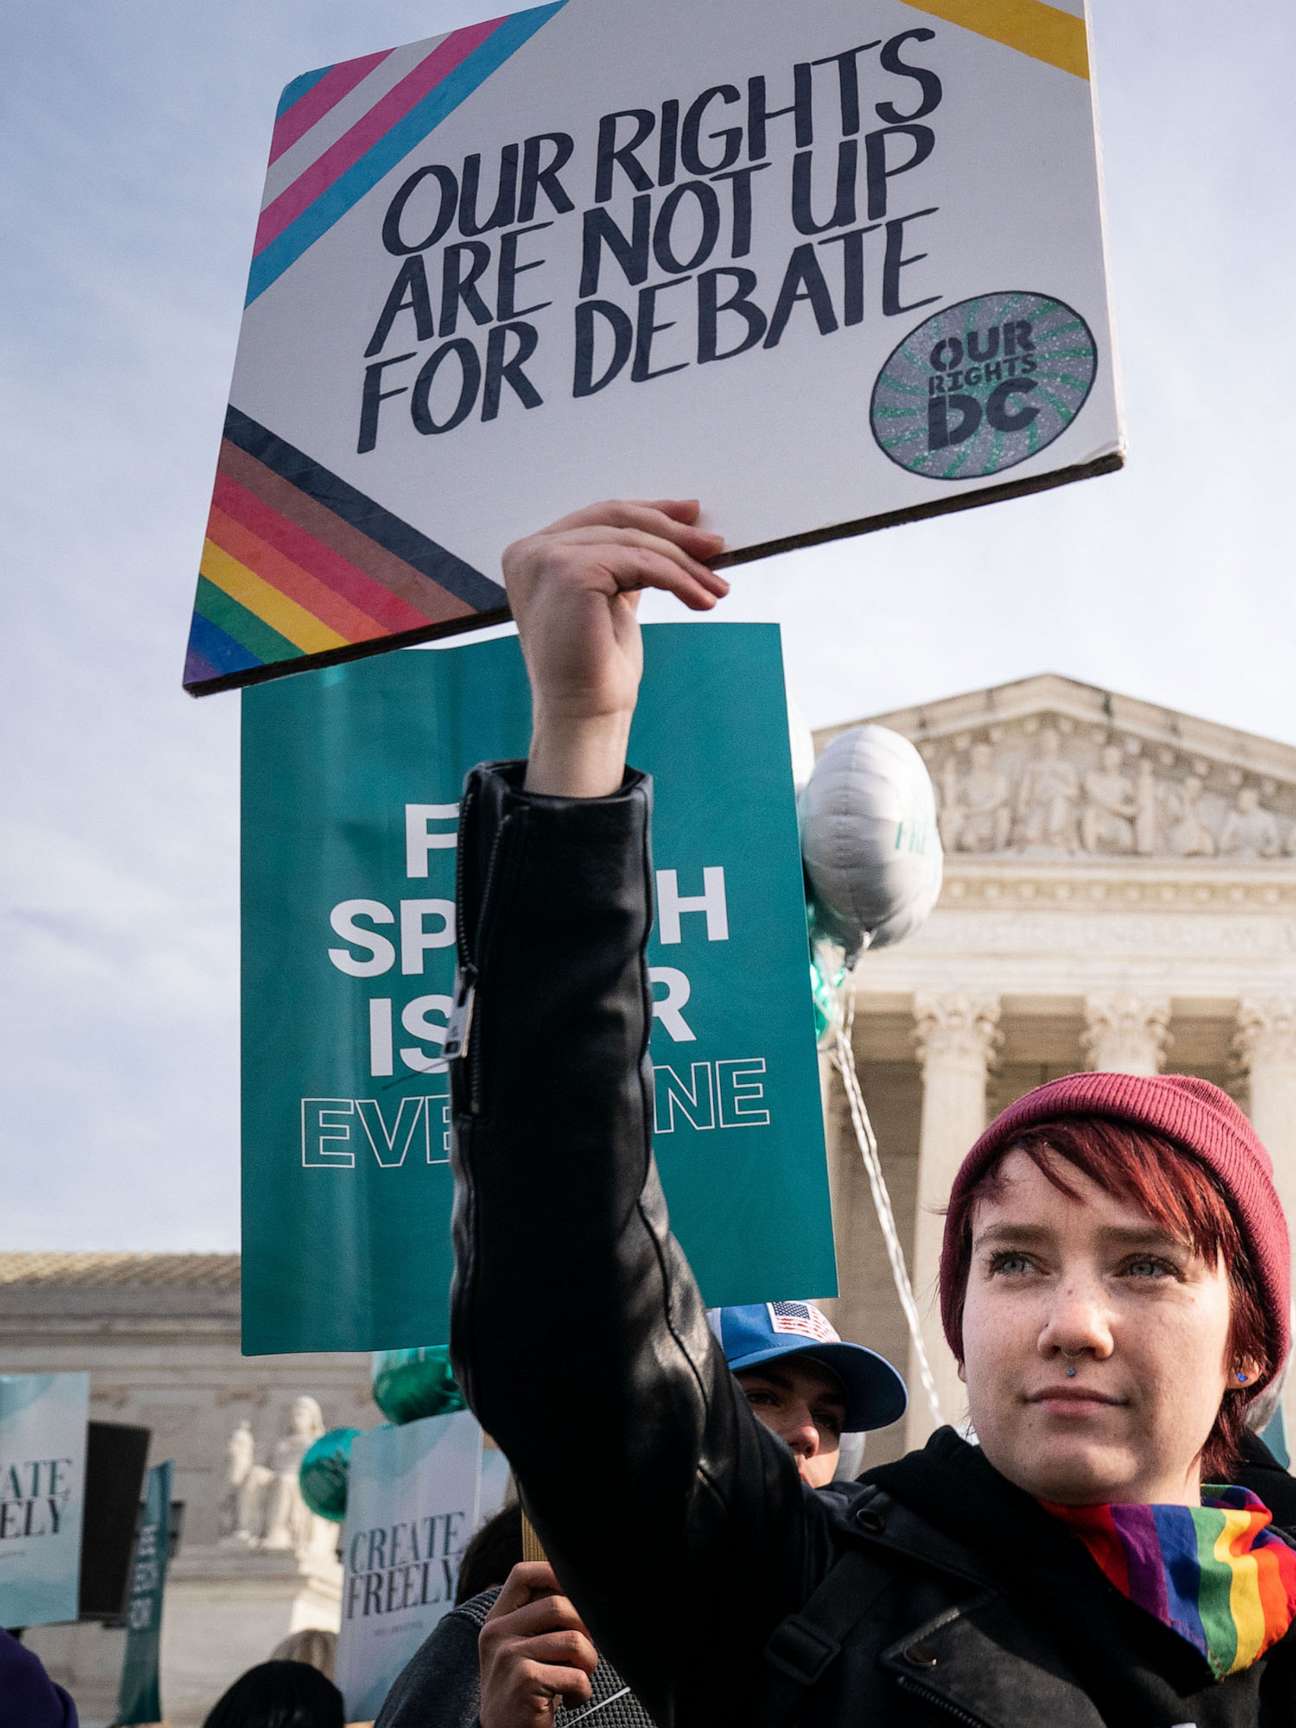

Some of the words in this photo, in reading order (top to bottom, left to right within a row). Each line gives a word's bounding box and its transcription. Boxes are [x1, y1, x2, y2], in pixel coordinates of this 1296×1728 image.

[381, 131, 575, 257] OUR
[598, 27, 943, 203] RIGHTS
[363, 222, 554, 358] ARE
[580, 162, 773, 298] NOT
[790, 123, 936, 236] UP
[356, 322, 544, 455] FOR
[572, 207, 944, 400] DEBATE
[929, 319, 1036, 372] OUR
[928, 353, 1038, 396] RIGHTS
[928, 377, 1041, 451] DC
[328, 866, 729, 978] SPH
[368, 994, 453, 1077] IS
[301, 1057, 770, 1168] EVNE
[0, 1458, 72, 1501] ATE
[0, 1498, 66, 1539] ELY
[352, 1511, 465, 1574] CREATE
[347, 1556, 460, 1619] FREELY
